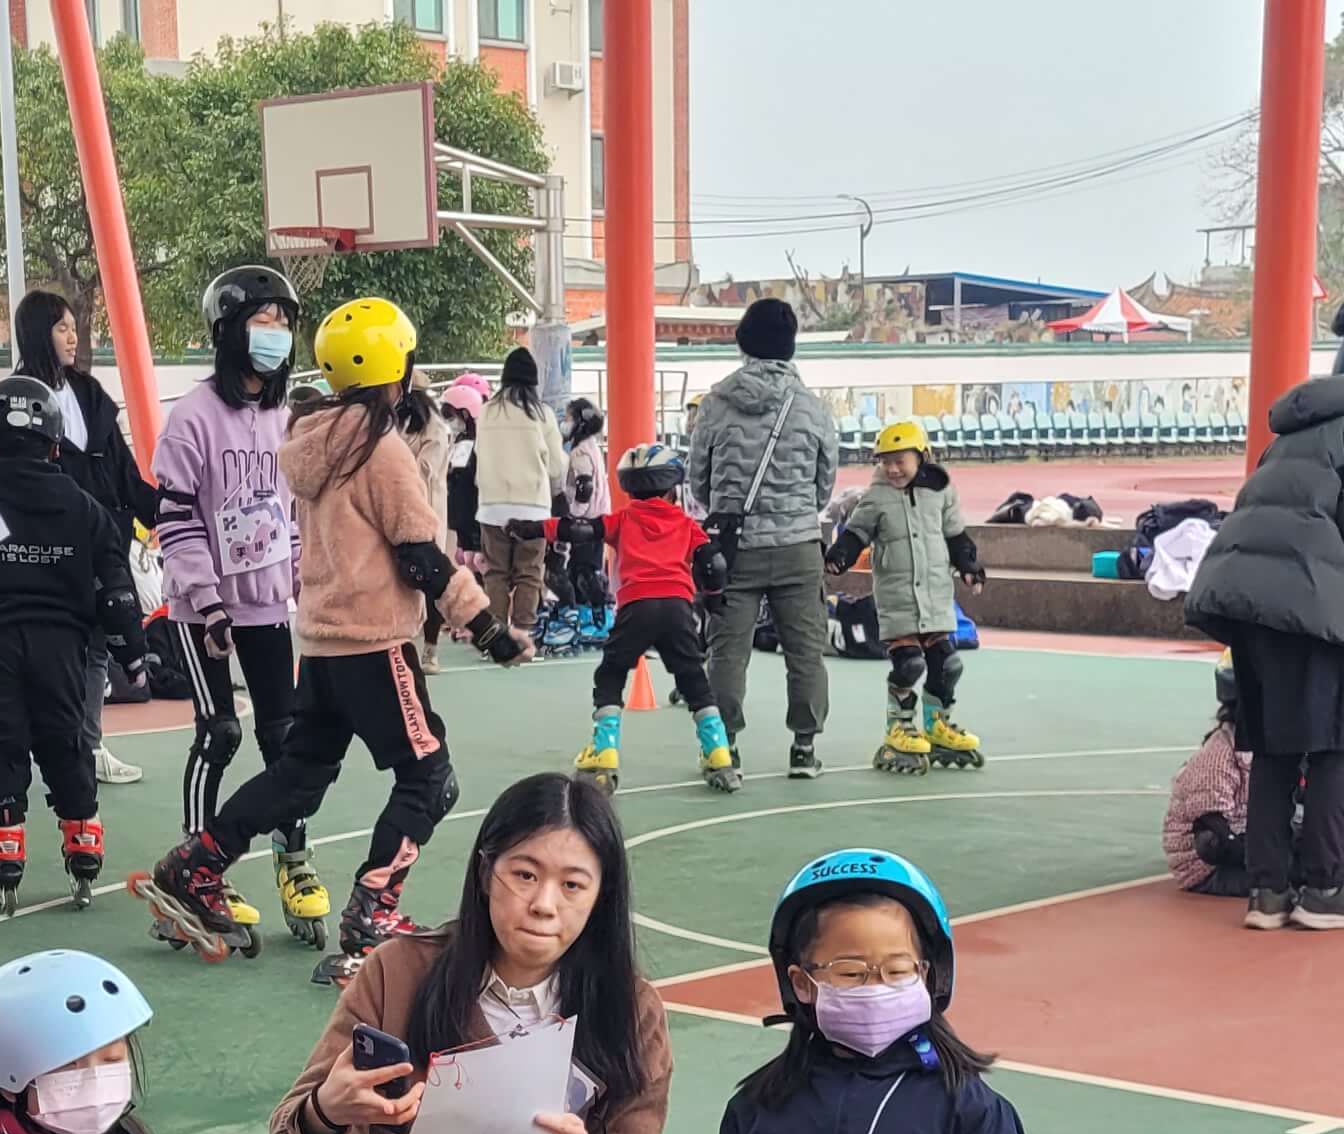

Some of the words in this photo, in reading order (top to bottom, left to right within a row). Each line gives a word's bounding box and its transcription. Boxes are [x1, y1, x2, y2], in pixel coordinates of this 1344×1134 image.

[1, 552, 16, 562] IS
[19, 554, 60, 564] LOST
[812, 863, 877, 880] SUCCESS
